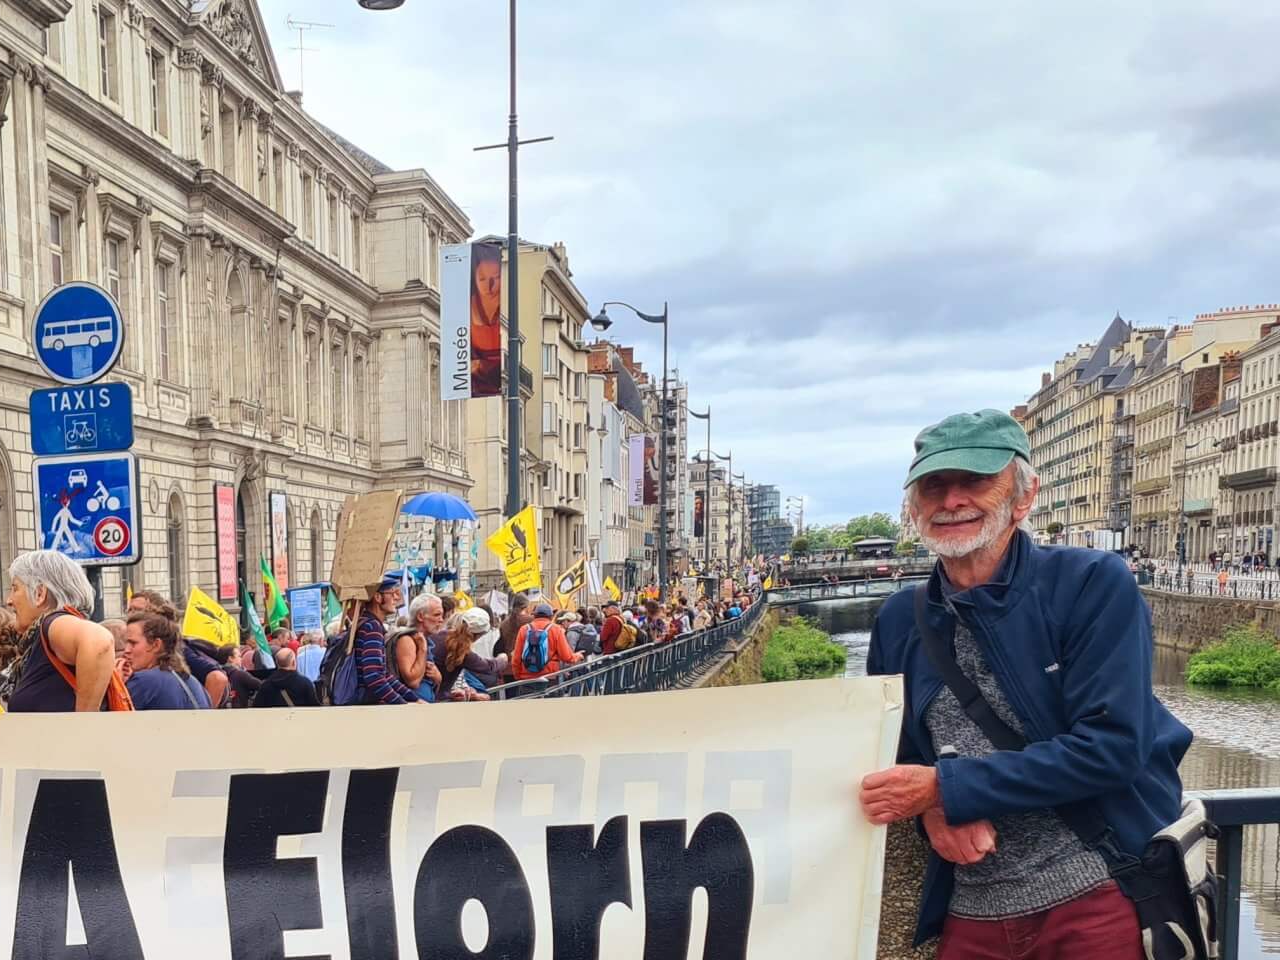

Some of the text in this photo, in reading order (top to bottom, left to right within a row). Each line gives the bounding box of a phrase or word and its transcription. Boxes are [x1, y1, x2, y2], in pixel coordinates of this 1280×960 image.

[452, 326, 468, 391] Musée
[47, 388, 111, 412] TAXIS
[102, 529, 121, 543] 20
